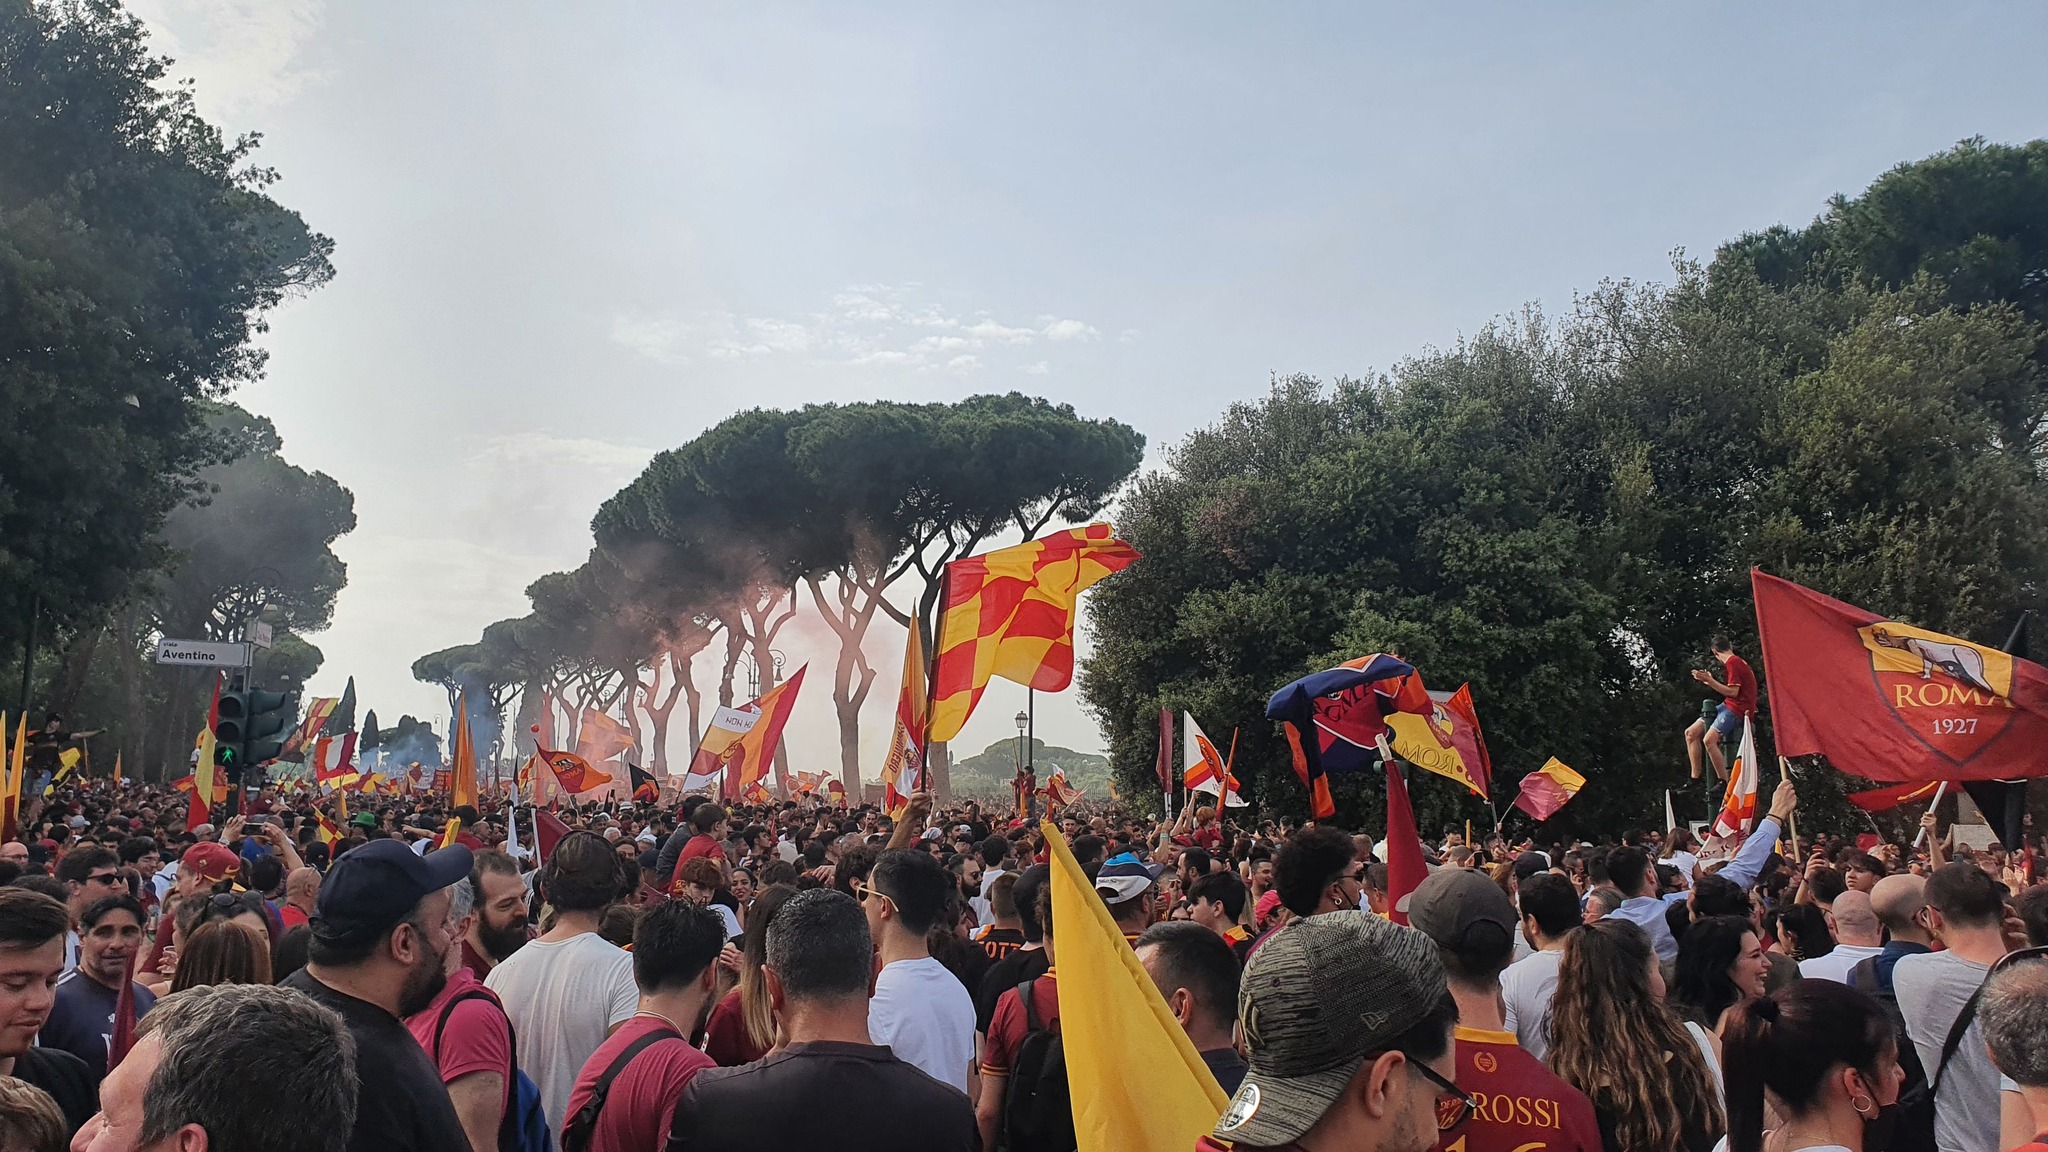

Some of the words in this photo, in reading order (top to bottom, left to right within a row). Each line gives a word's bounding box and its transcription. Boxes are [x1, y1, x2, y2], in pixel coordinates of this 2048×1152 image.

[162, 649, 216, 661] Aventino
[725, 716, 743, 728] NON
[1932, 718, 1978, 735] 1927
[1471, 1091, 1561, 1130] ROSSI
